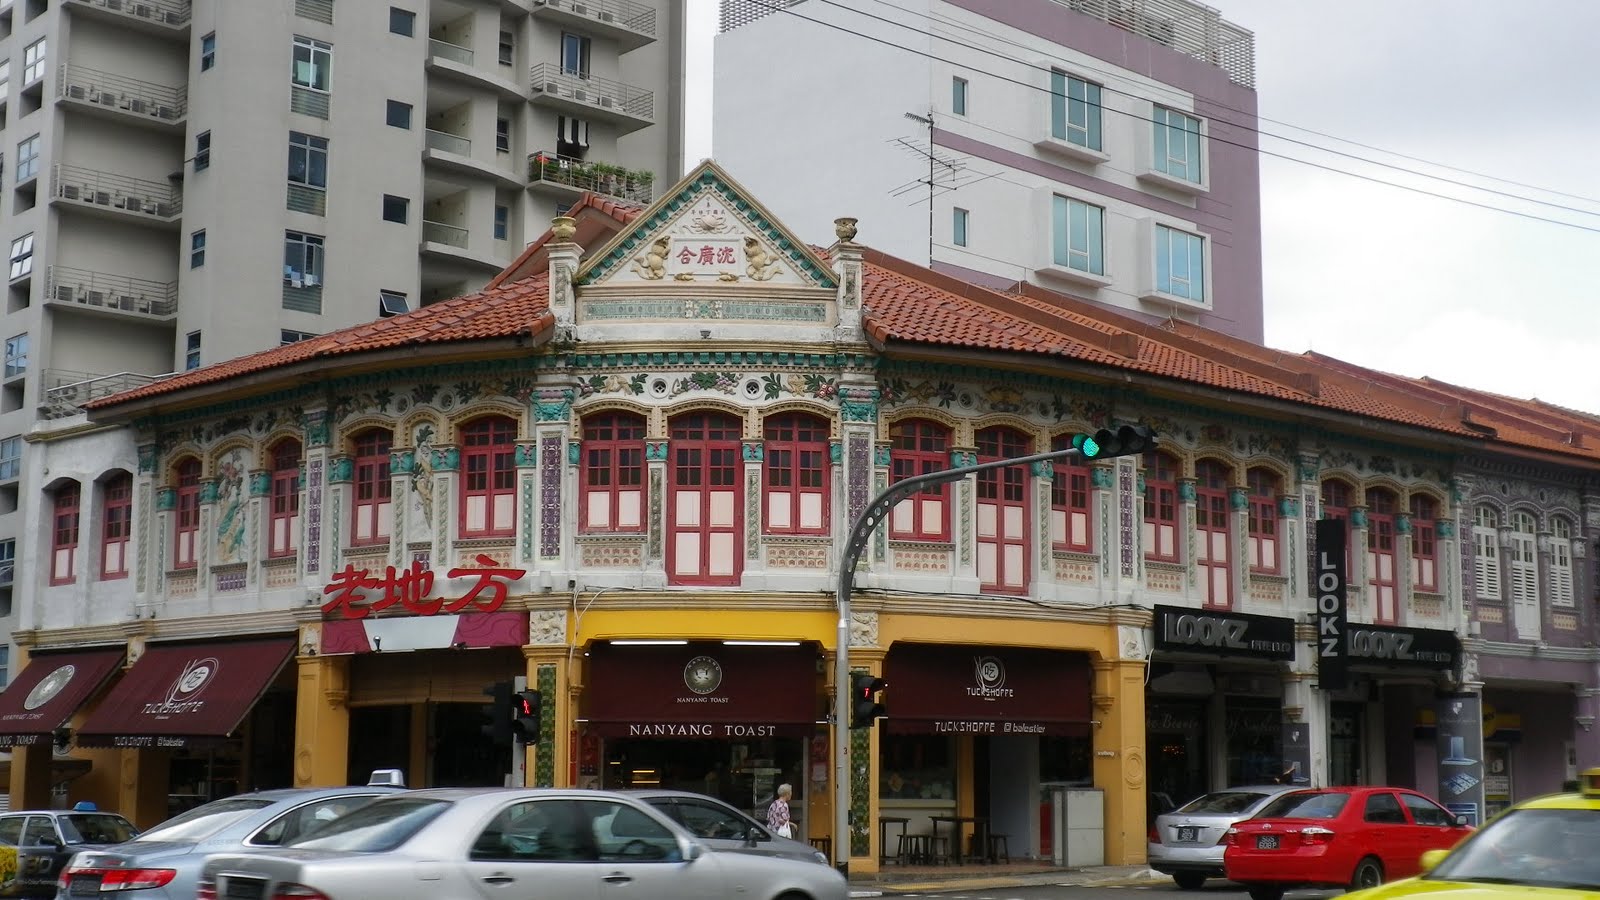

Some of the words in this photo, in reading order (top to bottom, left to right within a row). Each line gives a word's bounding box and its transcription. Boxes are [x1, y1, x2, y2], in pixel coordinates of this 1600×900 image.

[321, 554, 526, 619] 老地方
[1319, 552, 1340, 657] LOOKZ
[1164, 613, 1248, 649] LOOKZ
[1347, 629, 1414, 659] LOOKZ
[967, 687, 1014, 697] TUCKSHOPPE
[630, 724, 712, 736] NANYANG
[725, 725, 776, 736] TOAST
[935, 722, 995, 732] TUCKSHOPPE
[16, 735, 38, 744] TOAST
